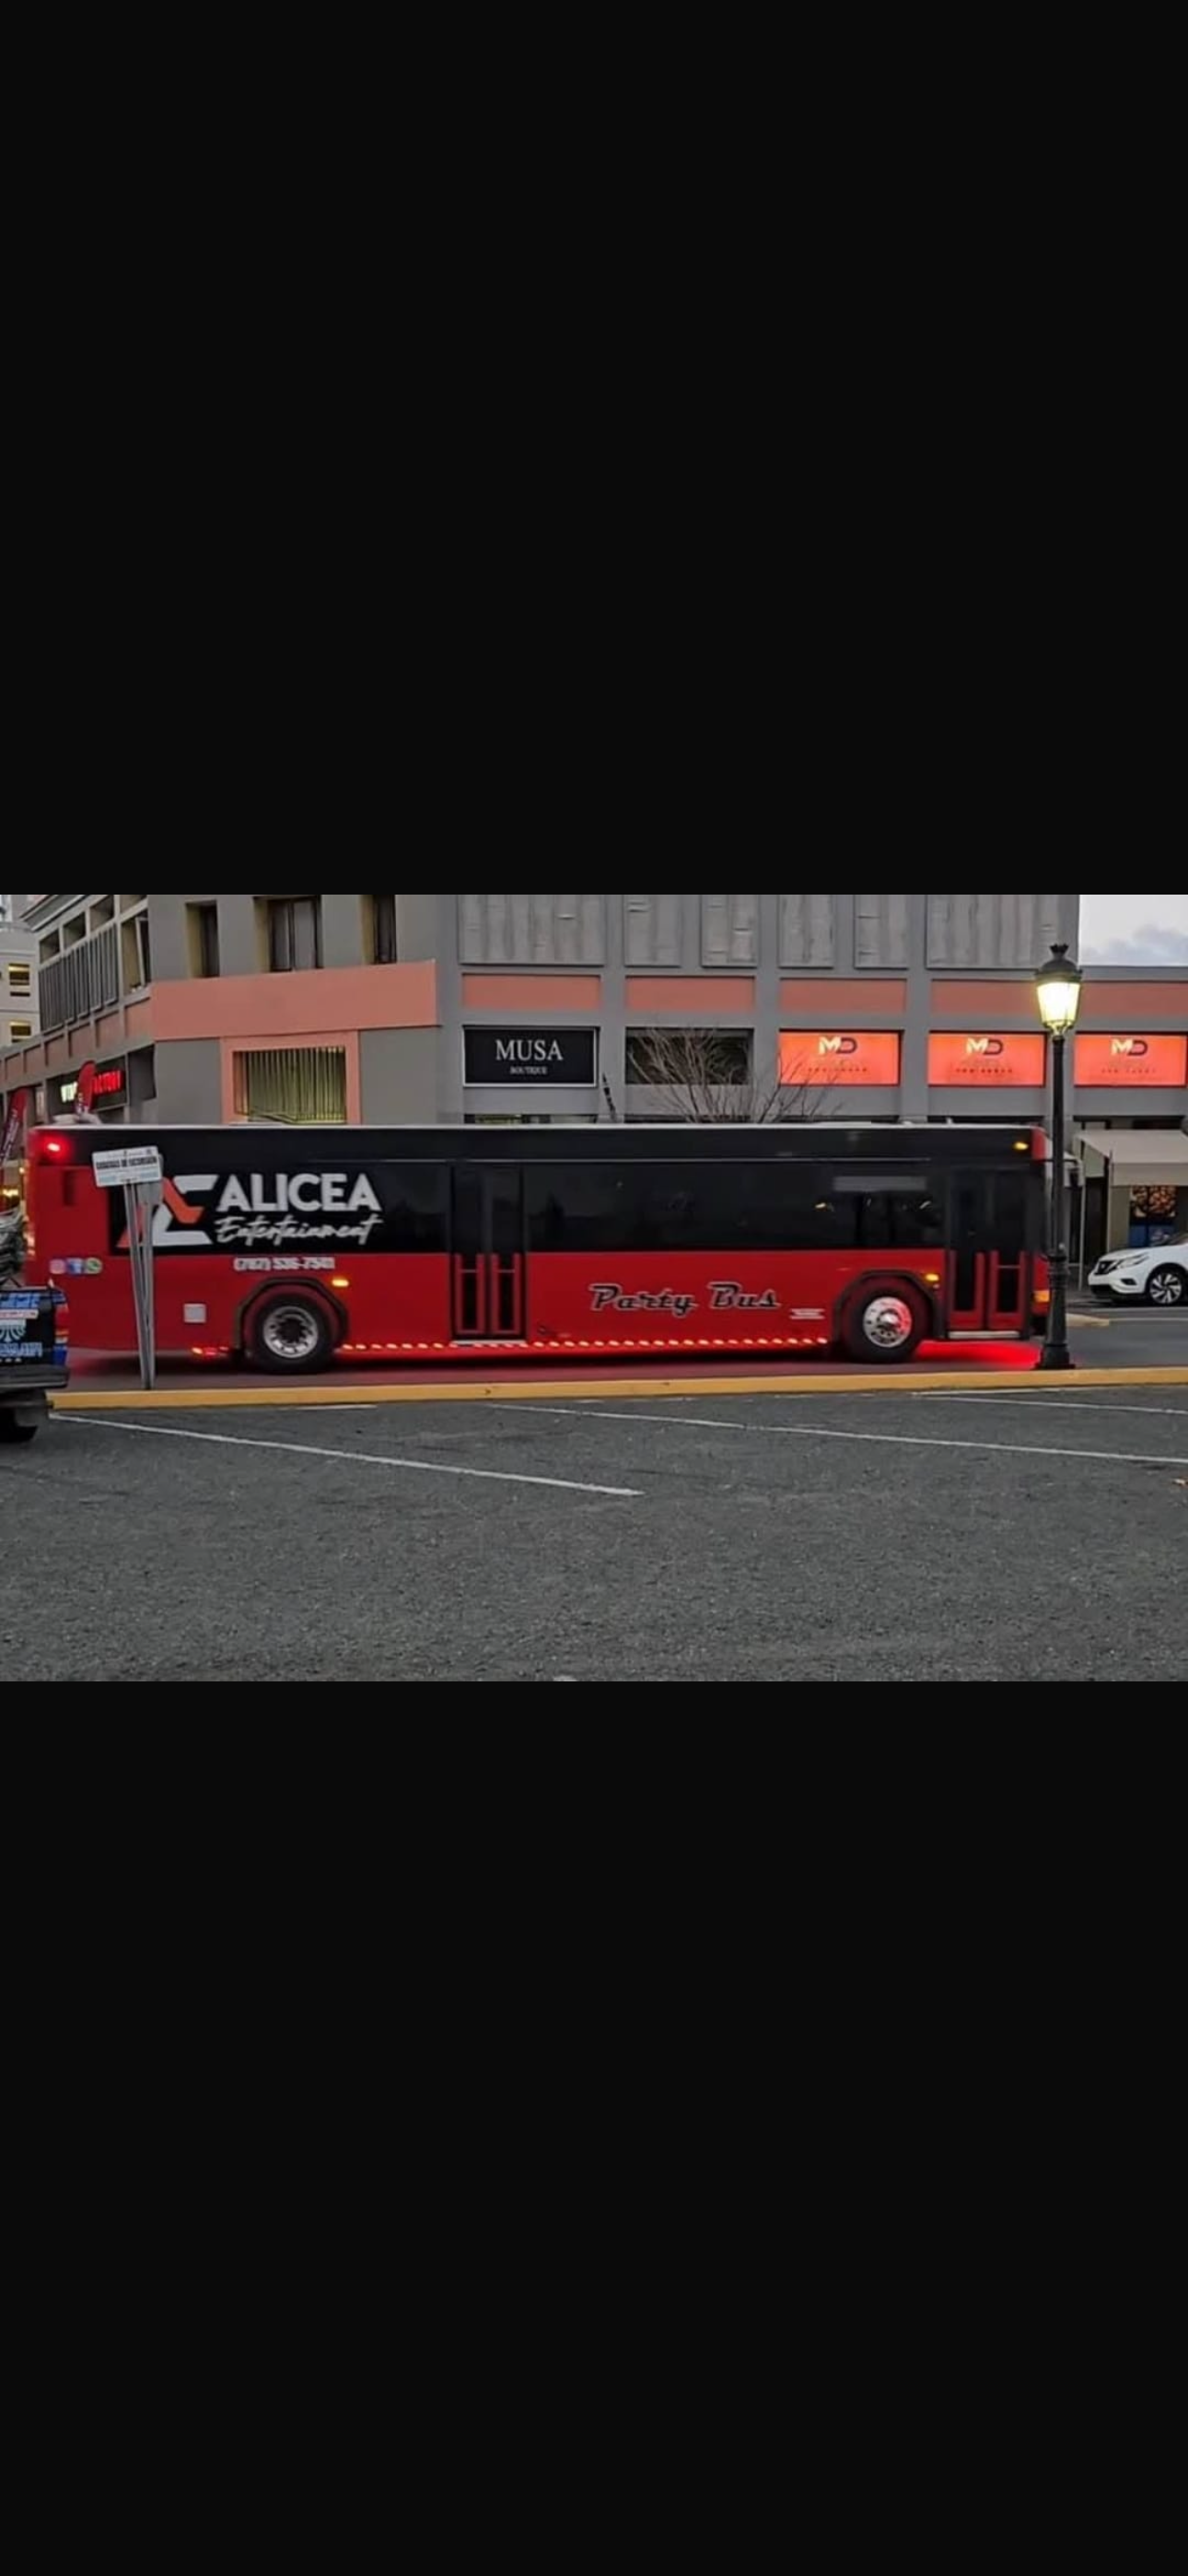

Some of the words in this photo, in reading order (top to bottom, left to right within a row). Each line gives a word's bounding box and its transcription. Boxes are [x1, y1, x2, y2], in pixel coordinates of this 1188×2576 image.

[495, 1039, 564, 1060] MUSA
[819, 1036, 858, 1055] MD
[966, 1037, 1004, 1056] MD
[1111, 1038, 1148, 1056] MD
[509, 1066, 548, 1075] BOUTIQUE
[215, 1173, 382, 1212] ALICEA
[214, 1213, 384, 1246] Entertainment
[589, 1282, 699, 1317] Party
[706, 1282, 781, 1308] Bus
